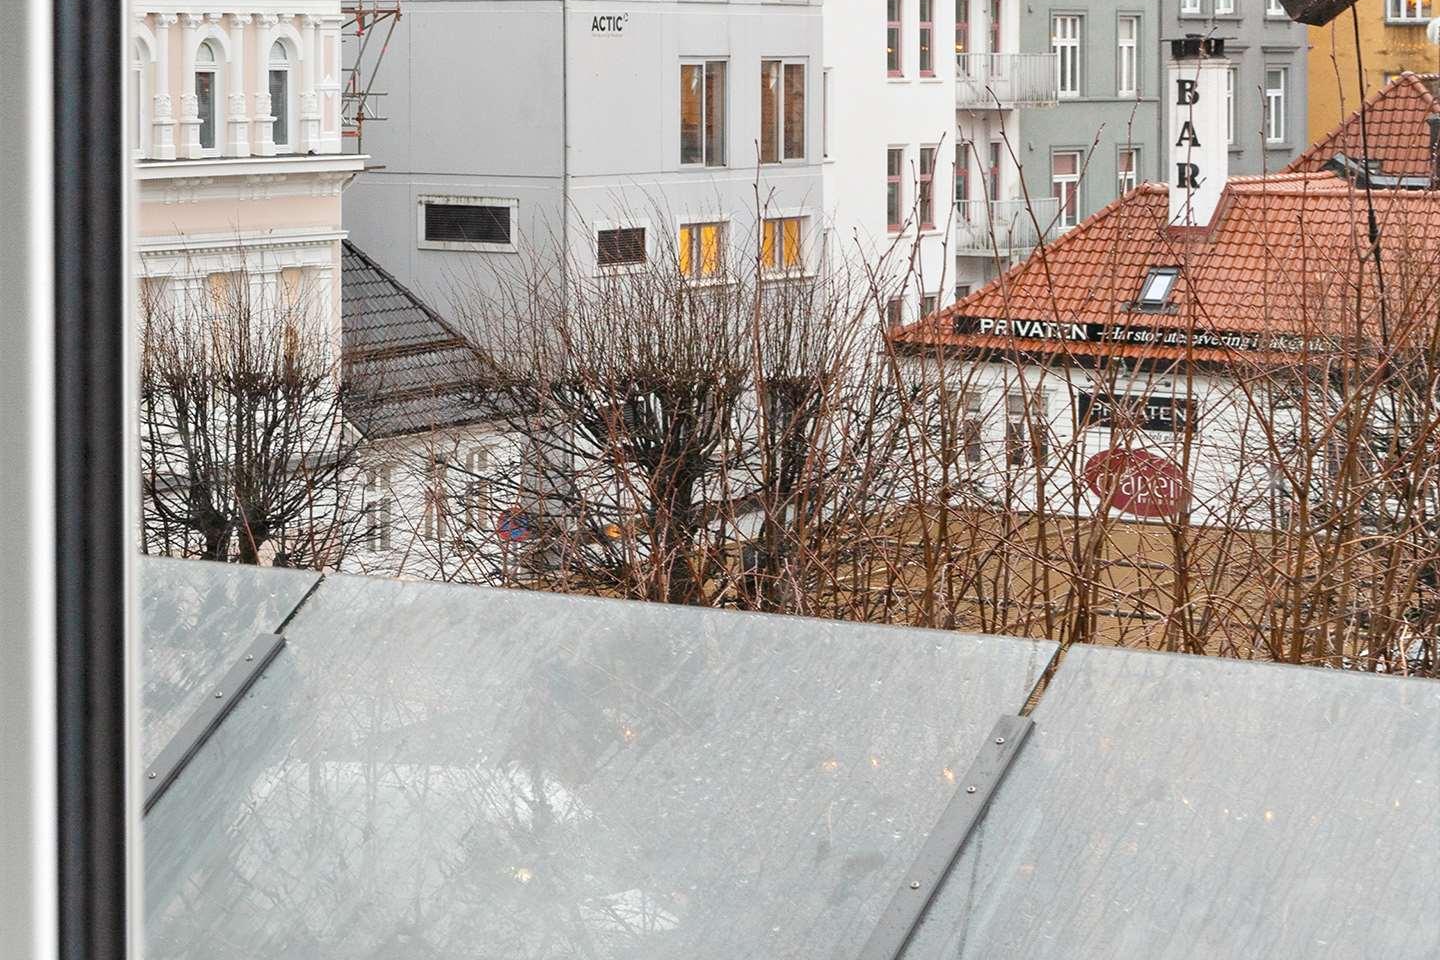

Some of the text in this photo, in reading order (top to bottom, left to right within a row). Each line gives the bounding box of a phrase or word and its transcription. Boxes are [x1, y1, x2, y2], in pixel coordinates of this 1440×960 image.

[591, 15, 623, 31] ACTIC
[1175, 79, 1201, 189] BAR
[979, 318, 1088, 340] PRIVATEN
